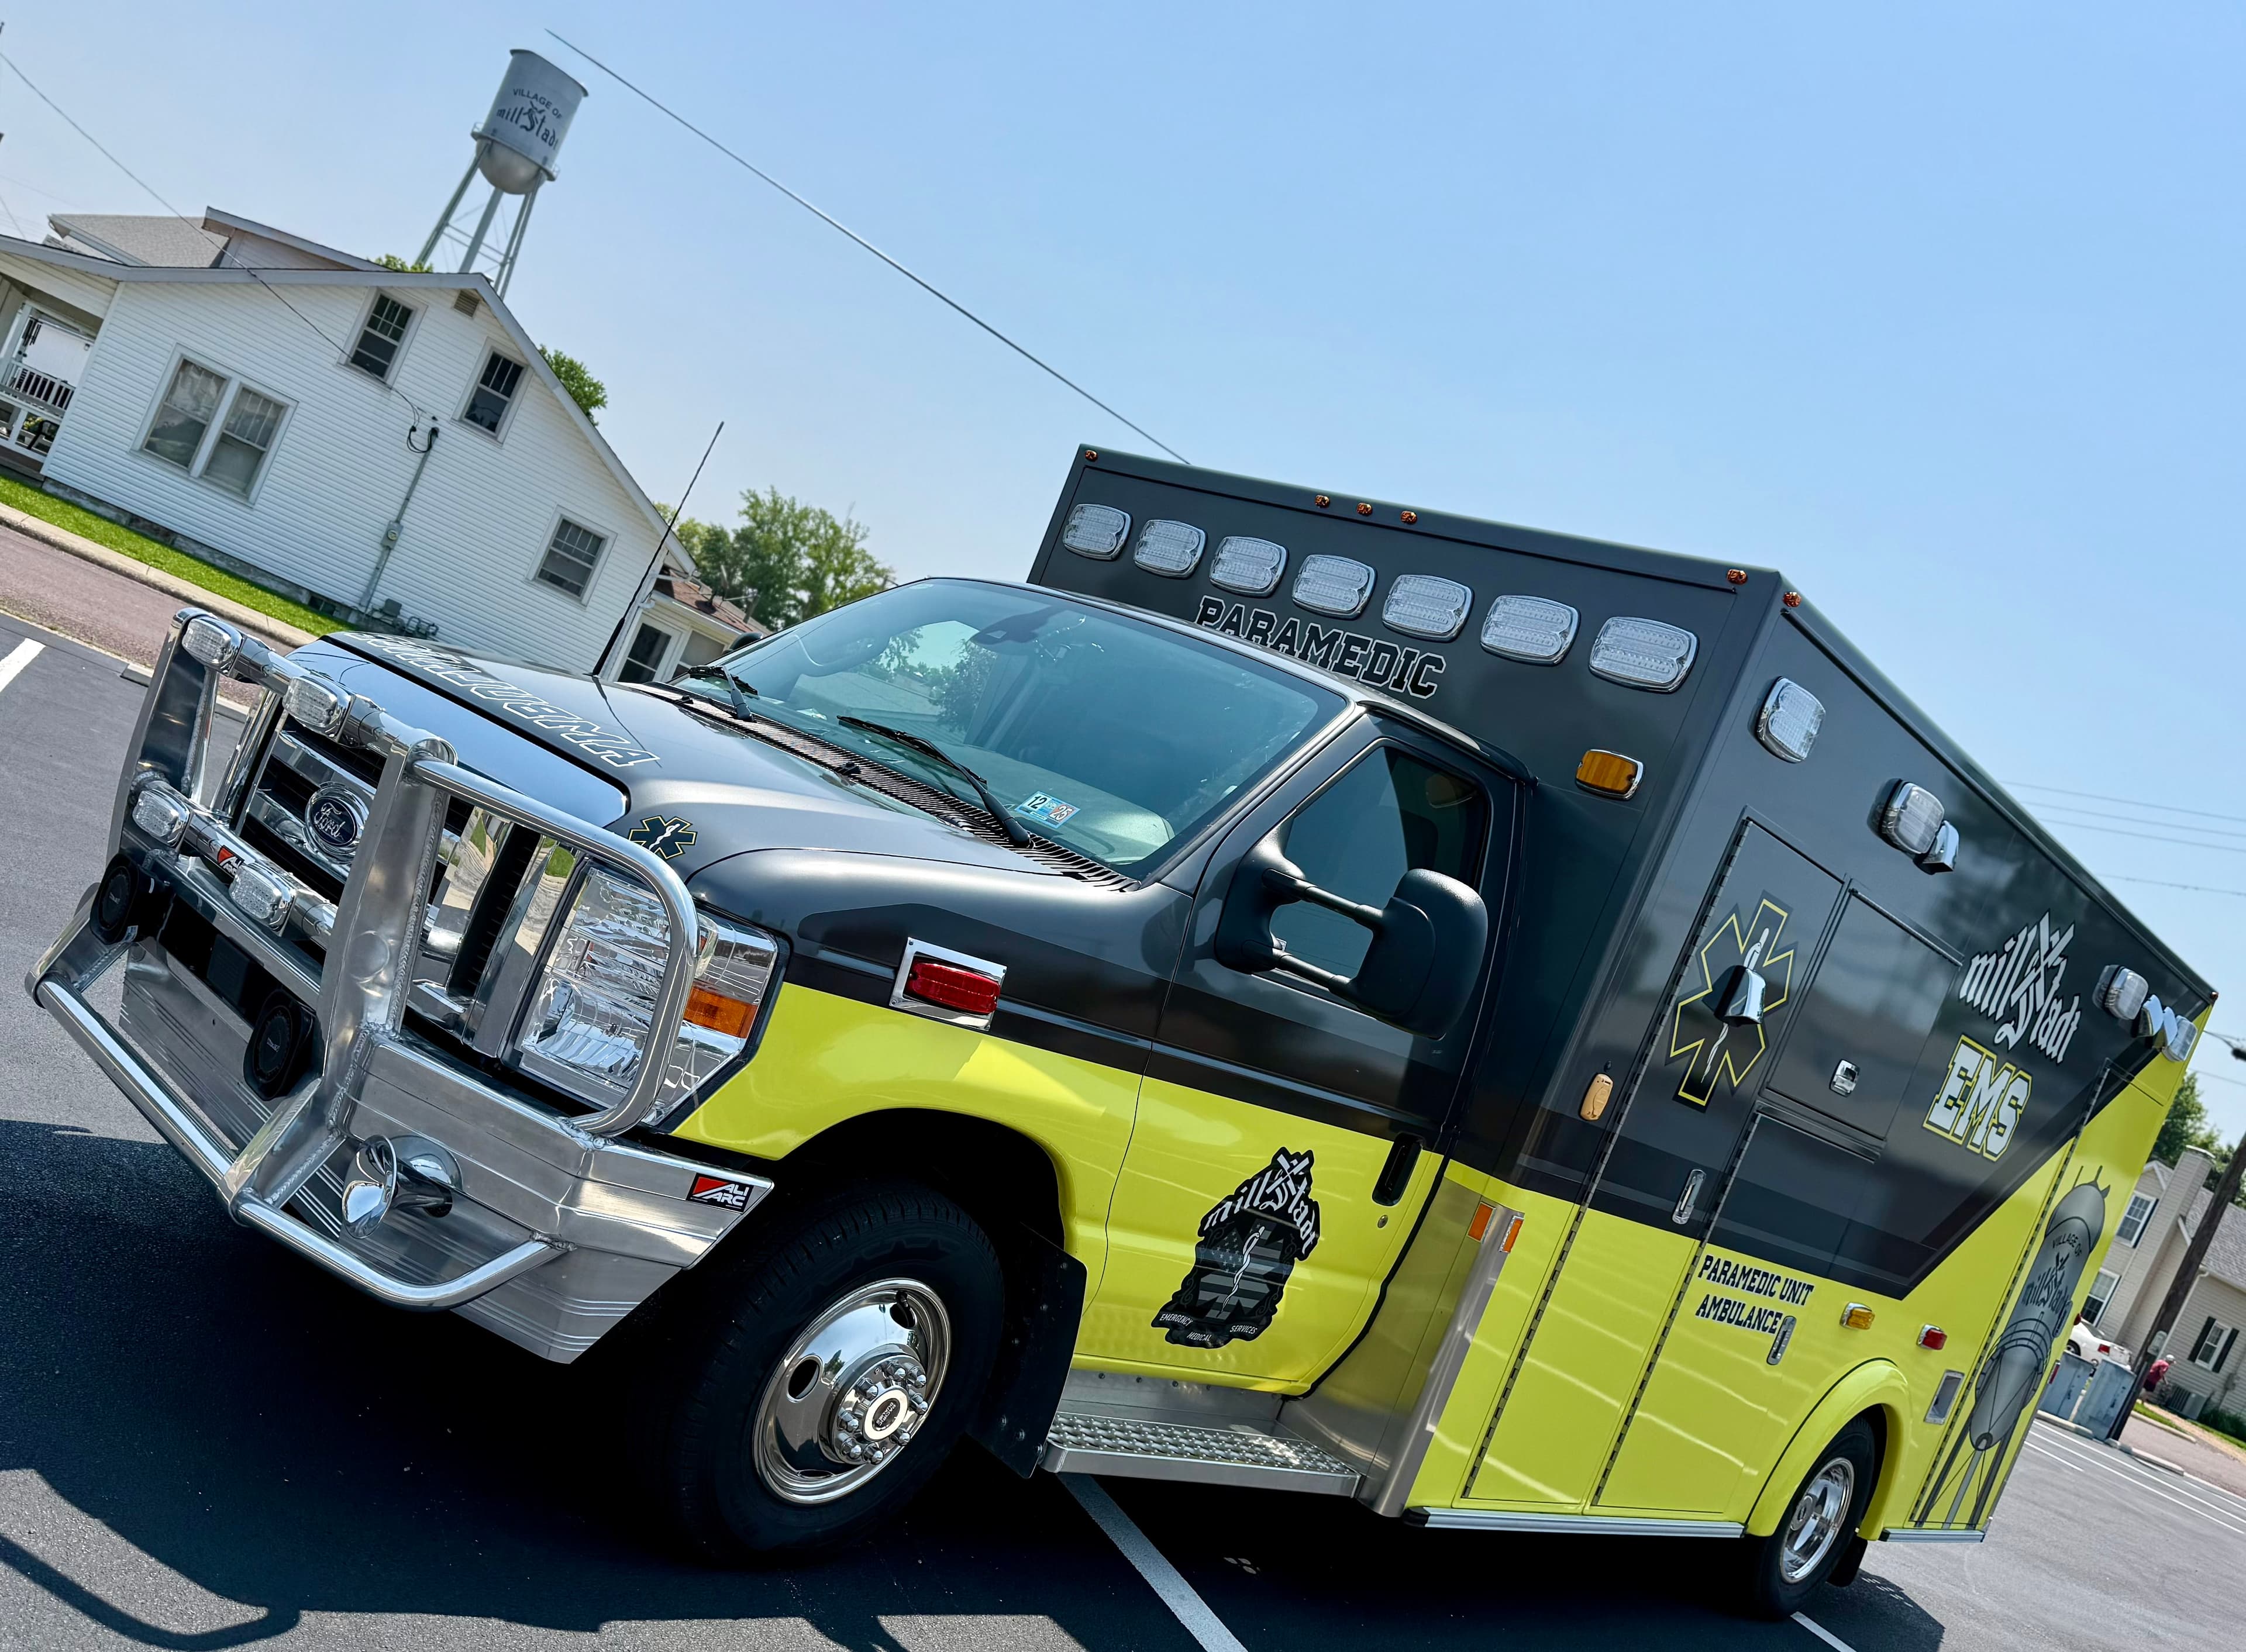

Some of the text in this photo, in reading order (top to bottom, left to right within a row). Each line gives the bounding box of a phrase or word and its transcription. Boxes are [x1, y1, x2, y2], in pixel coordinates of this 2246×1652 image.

[513, 88, 562, 119] VILLAGE OF
[1196, 595, 1446, 699] PARAMEDIC
[314, 802, 346, 840] Ford
[1028, 796, 1047, 809] 12
[1049, 805, 1074, 821] 25
[1923, 1034, 2033, 1162] EMS
[693, 1183, 749, 1197] ALI
[702, 1192, 746, 1207] ARC
[1698, 1255, 1814, 1306] PARAMEDIC UNIT
[1159, 1313, 1258, 1342] EMERGENCY MEDICAL SERVICES
[1695, 1294, 1783, 1334] AMBULANCE
